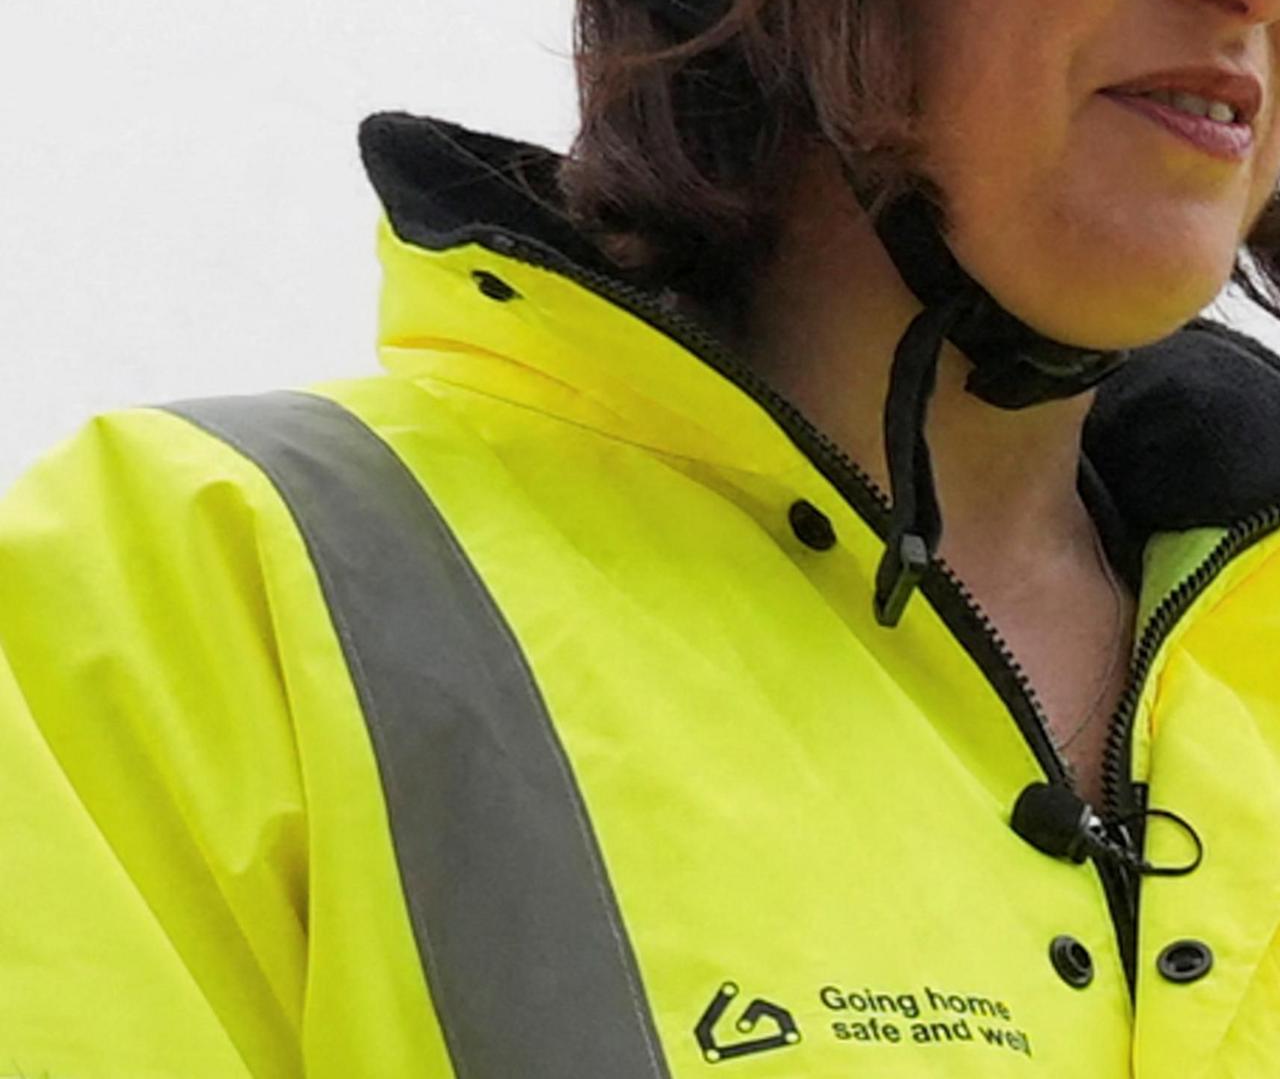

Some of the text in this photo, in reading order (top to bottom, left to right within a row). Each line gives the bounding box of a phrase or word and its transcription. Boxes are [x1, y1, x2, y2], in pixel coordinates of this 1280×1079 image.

[820, 986, 1011, 1021] Going home
[832, 1018, 901, 1043] safe
[911, 1019, 973, 1043] and
